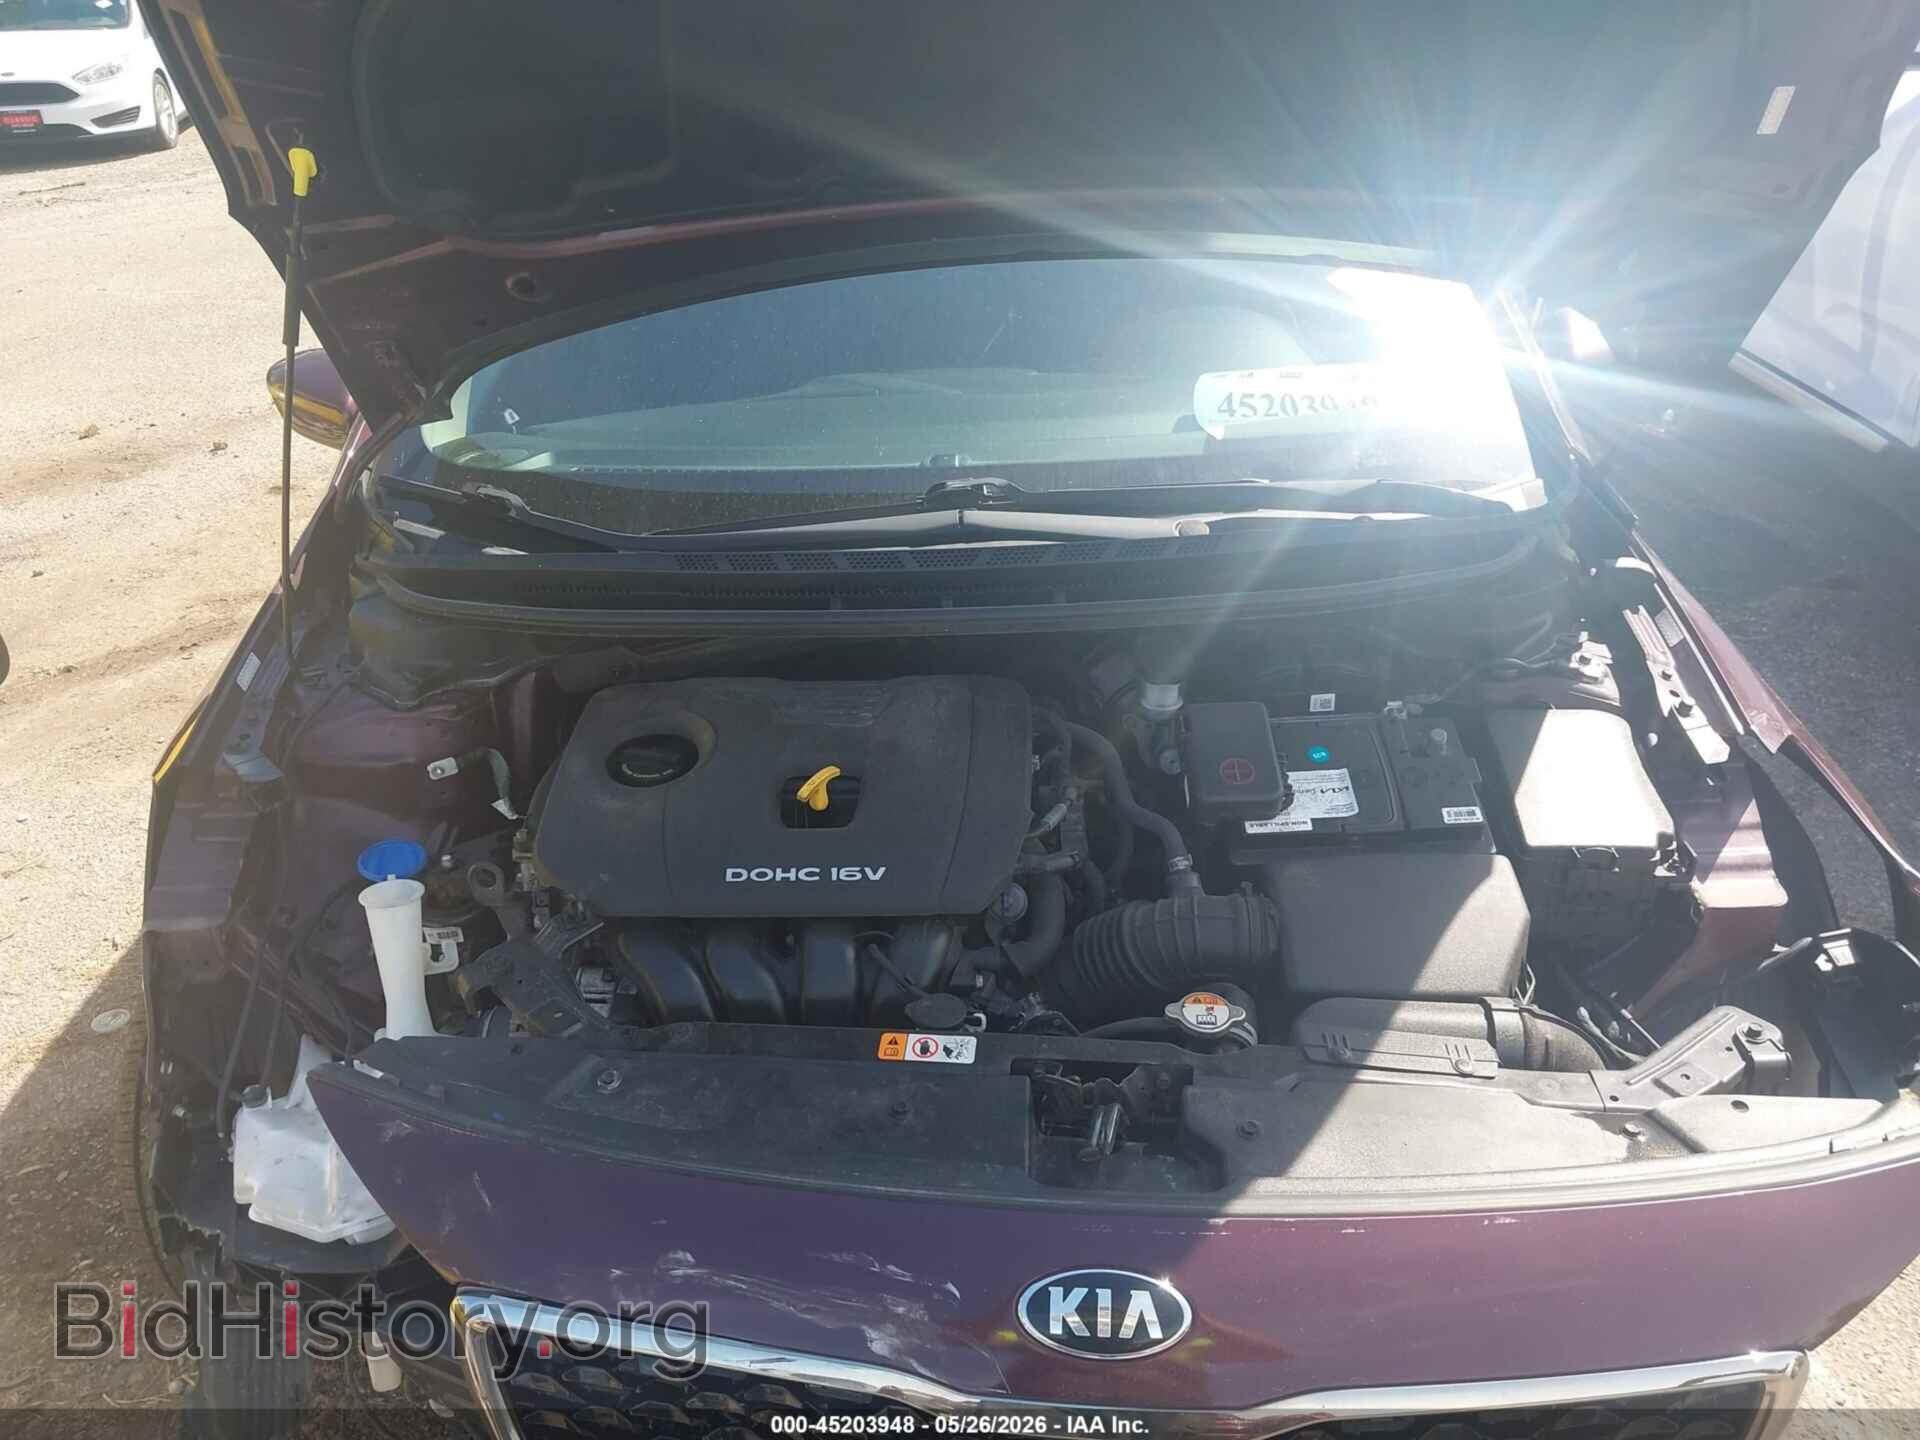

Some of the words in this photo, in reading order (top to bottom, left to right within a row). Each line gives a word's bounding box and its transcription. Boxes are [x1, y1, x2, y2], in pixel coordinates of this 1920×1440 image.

[725, 867, 821, 882] DOHC
[830, 866, 887, 881] 16V
[1048, 1286, 1164, 1340] KIA
